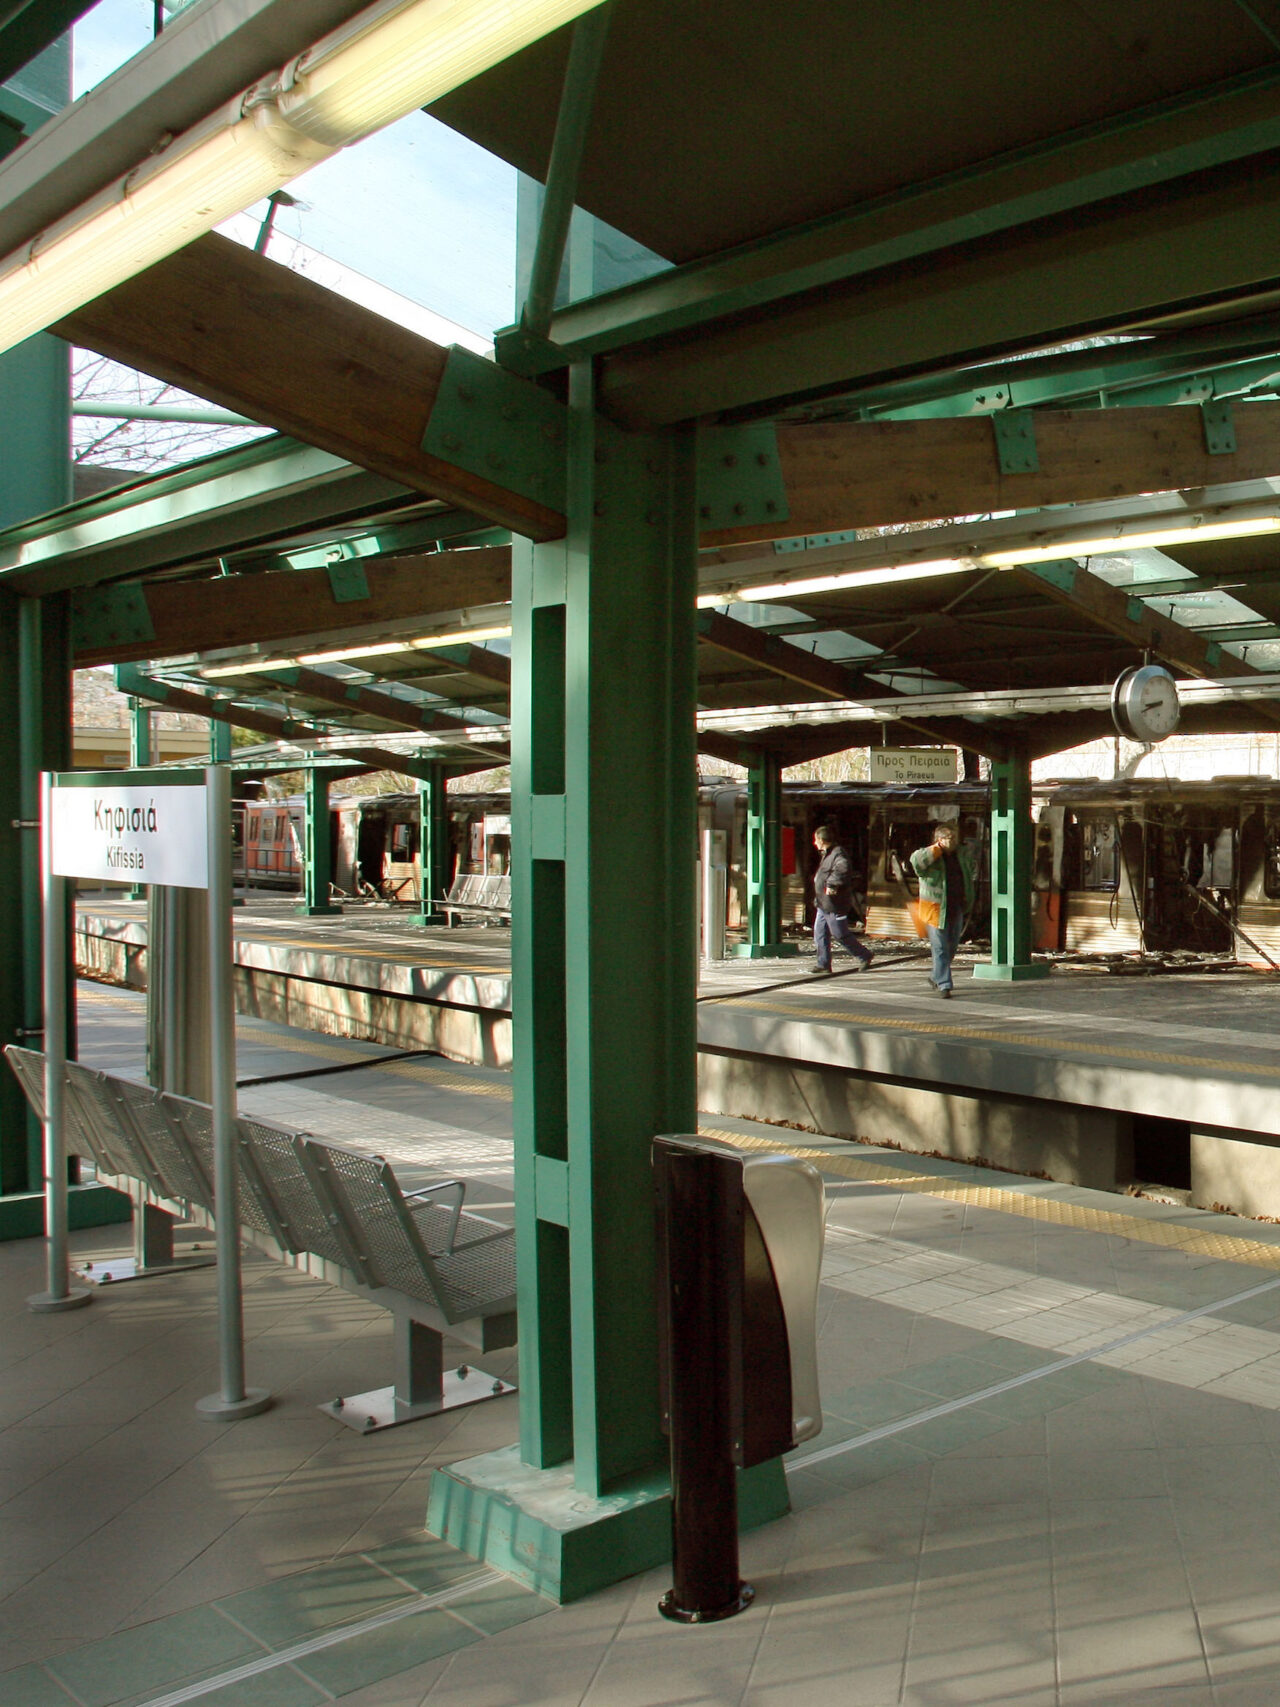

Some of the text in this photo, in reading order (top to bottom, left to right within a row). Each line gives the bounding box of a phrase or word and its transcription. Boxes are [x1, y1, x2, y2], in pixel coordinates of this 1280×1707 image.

[894, 770, 935, 779] To Piraeus
[94, 798, 158, 839] Κηφισιά
[107, 846, 144, 870] Kifissia
